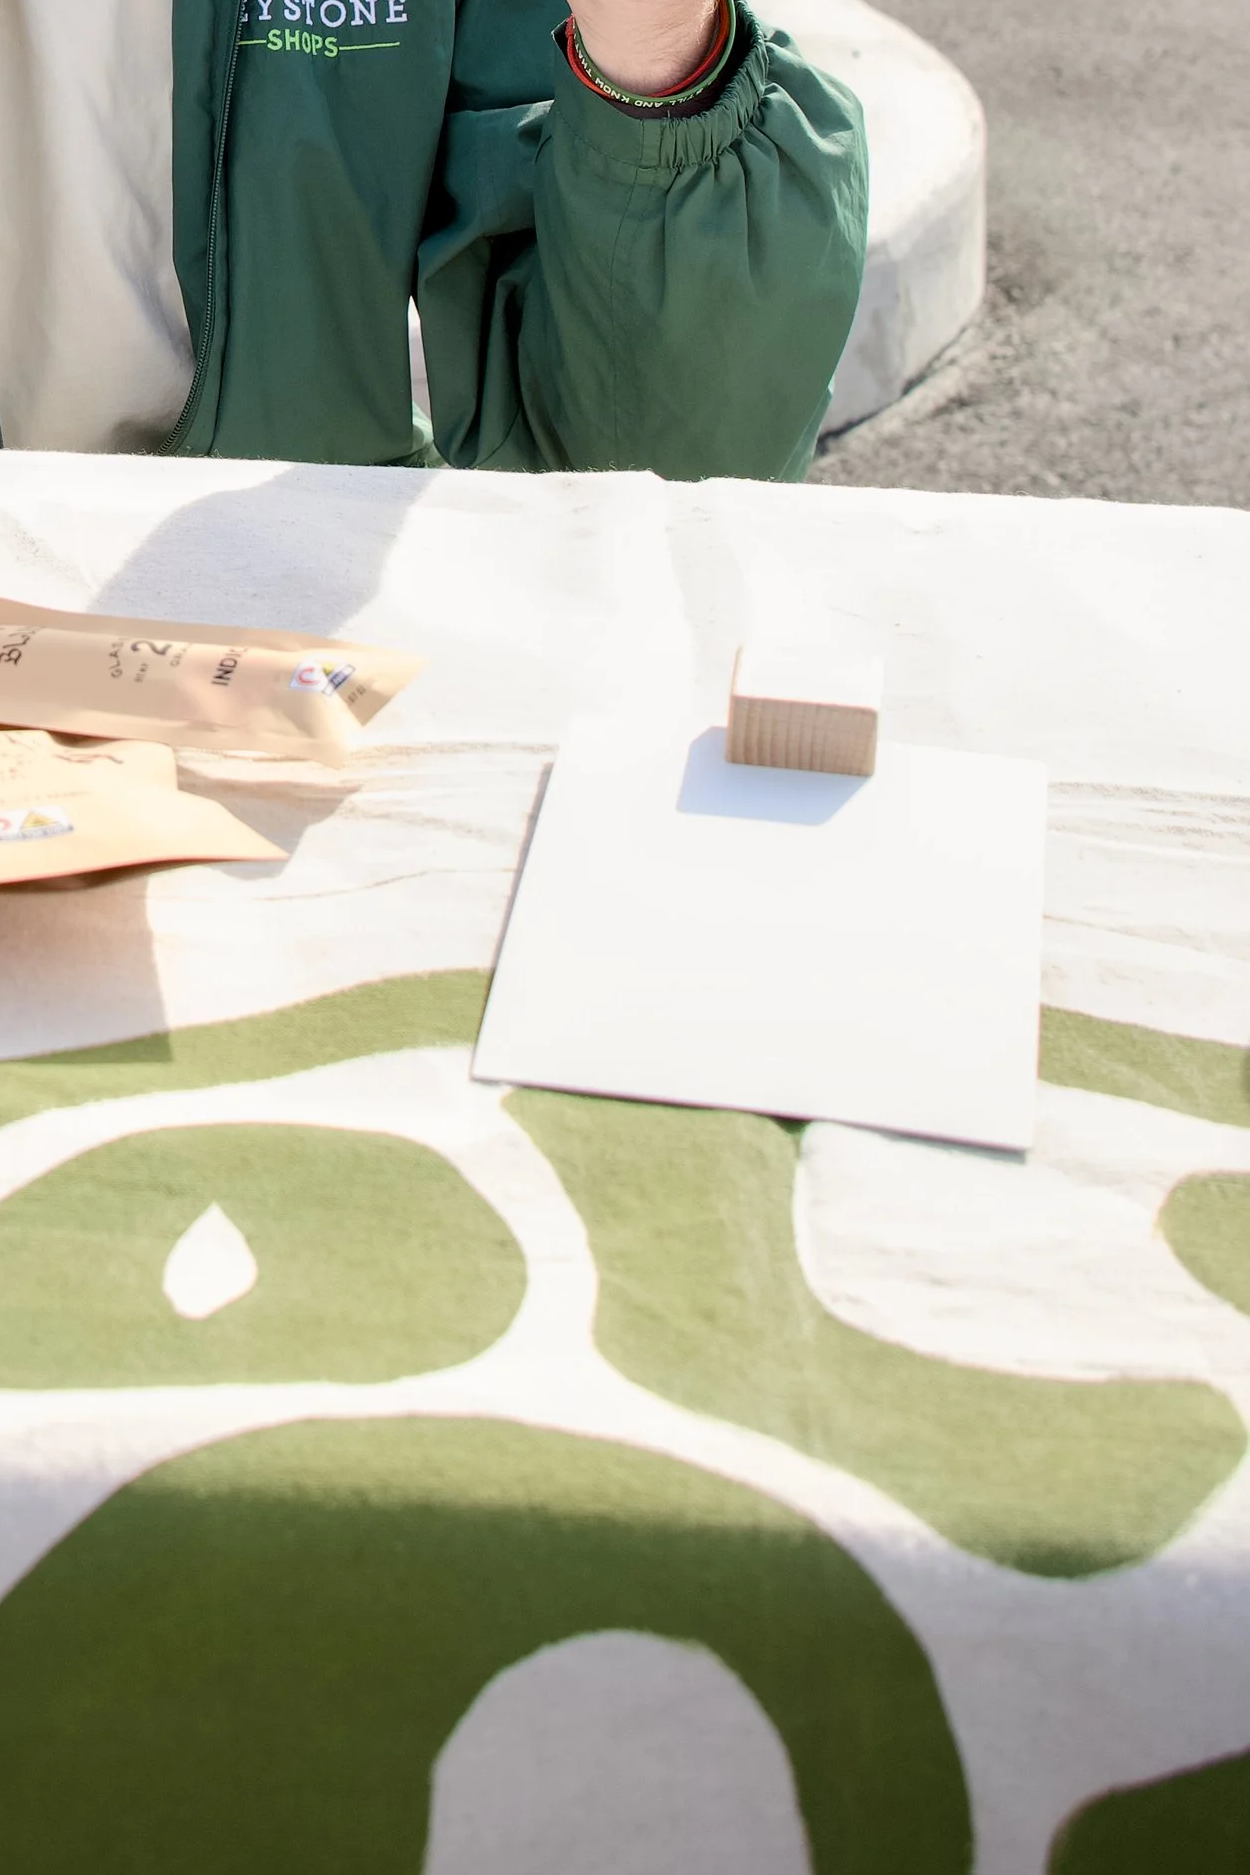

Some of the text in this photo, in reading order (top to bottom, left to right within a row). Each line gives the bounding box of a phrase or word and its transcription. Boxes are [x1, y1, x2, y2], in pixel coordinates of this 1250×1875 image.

[266, 28, 339, 58] SHOPS
[594, 77, 630, 104] KNOW
[634, 100, 663, 108] AND
